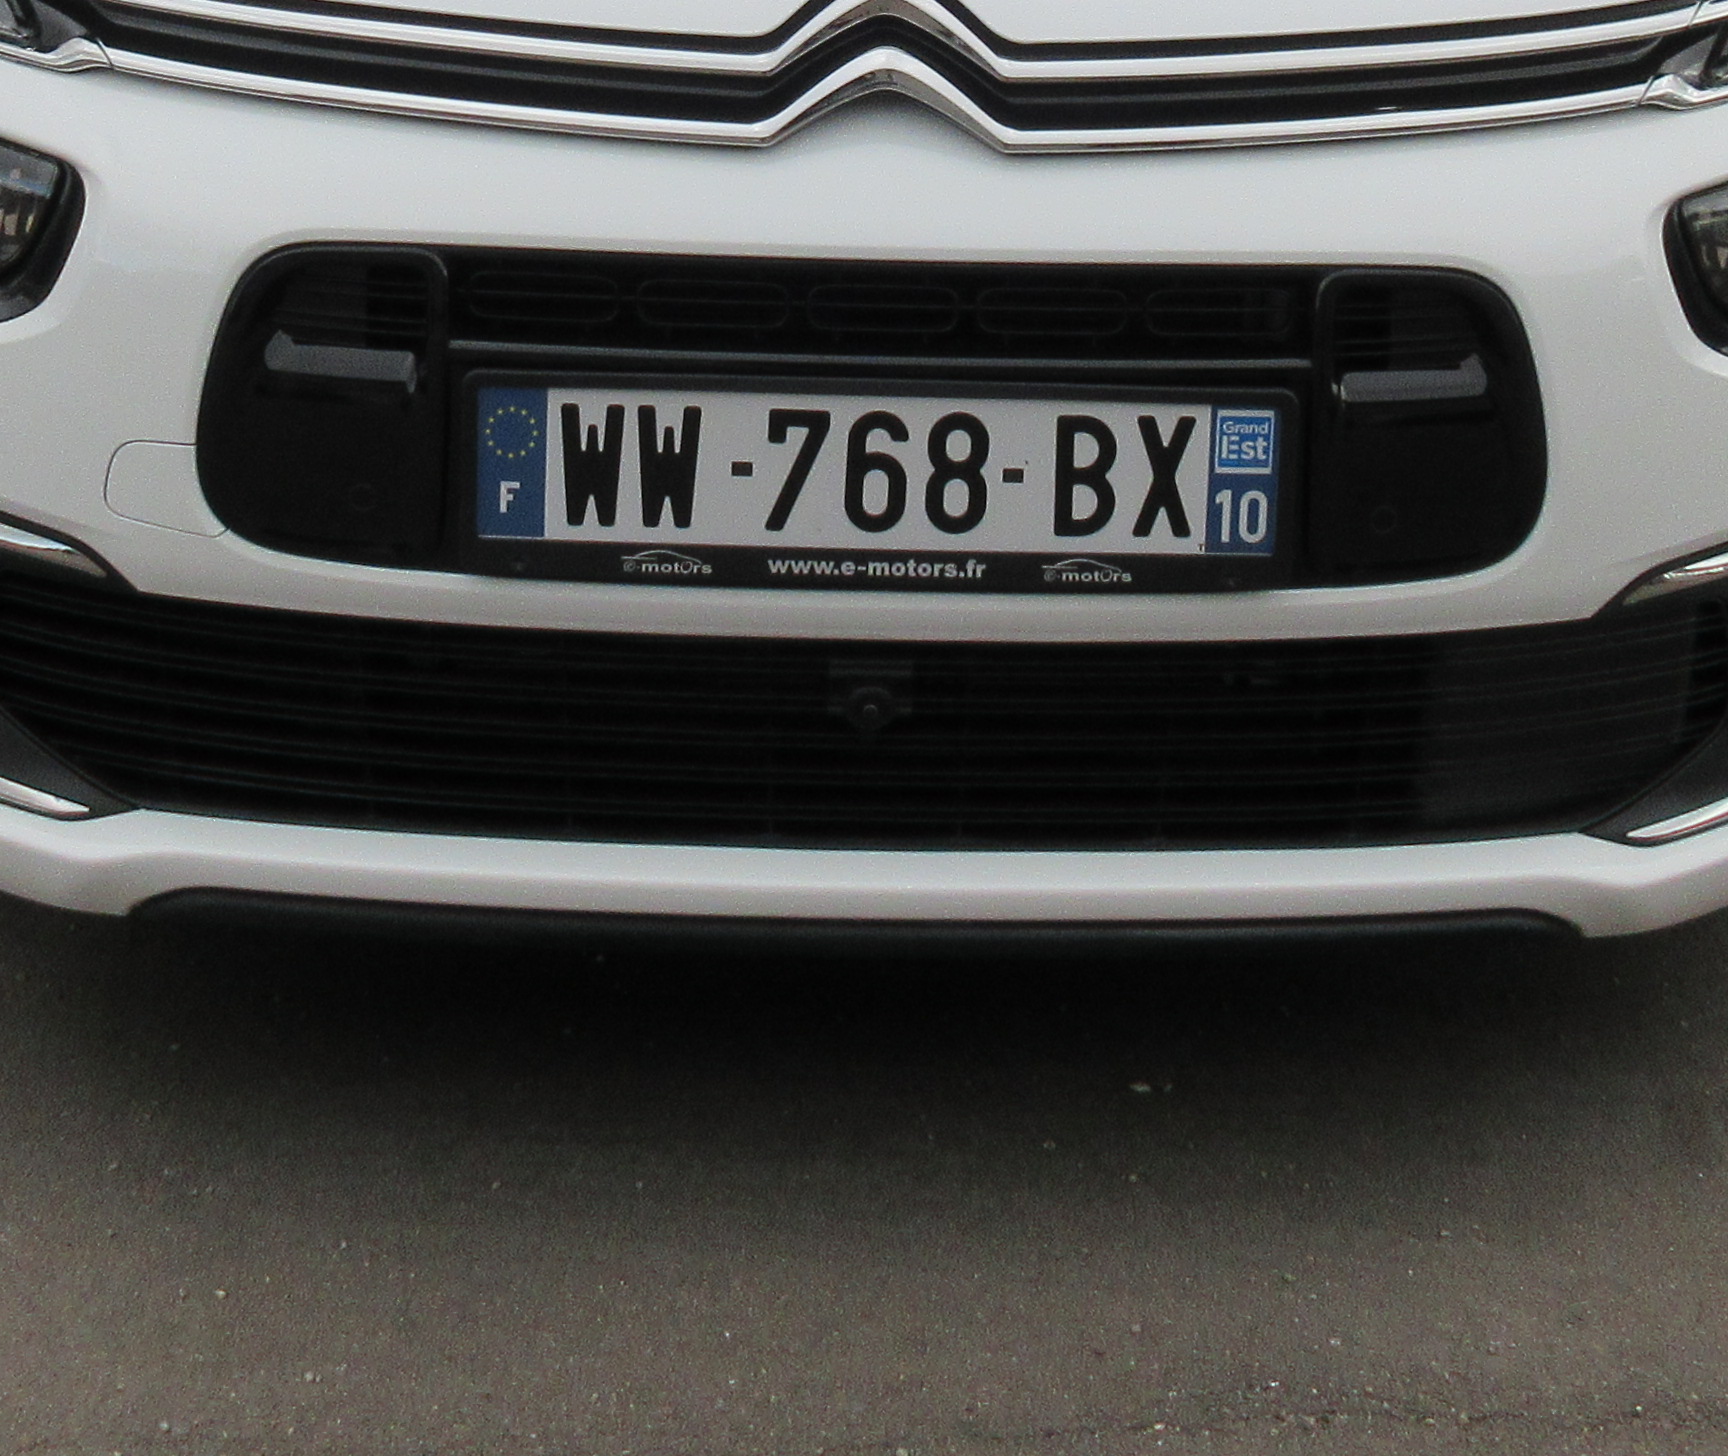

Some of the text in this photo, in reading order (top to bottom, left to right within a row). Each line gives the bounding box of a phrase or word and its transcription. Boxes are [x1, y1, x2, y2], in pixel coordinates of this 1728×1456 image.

[1222, 420, 1270, 435] Grand
[1221, 435, 1269, 461] Est
[500, 480, 520, 514] F
[1215, 488, 1269, 544] 10
[766, 558, 987, 579] www.e-motors.fr
